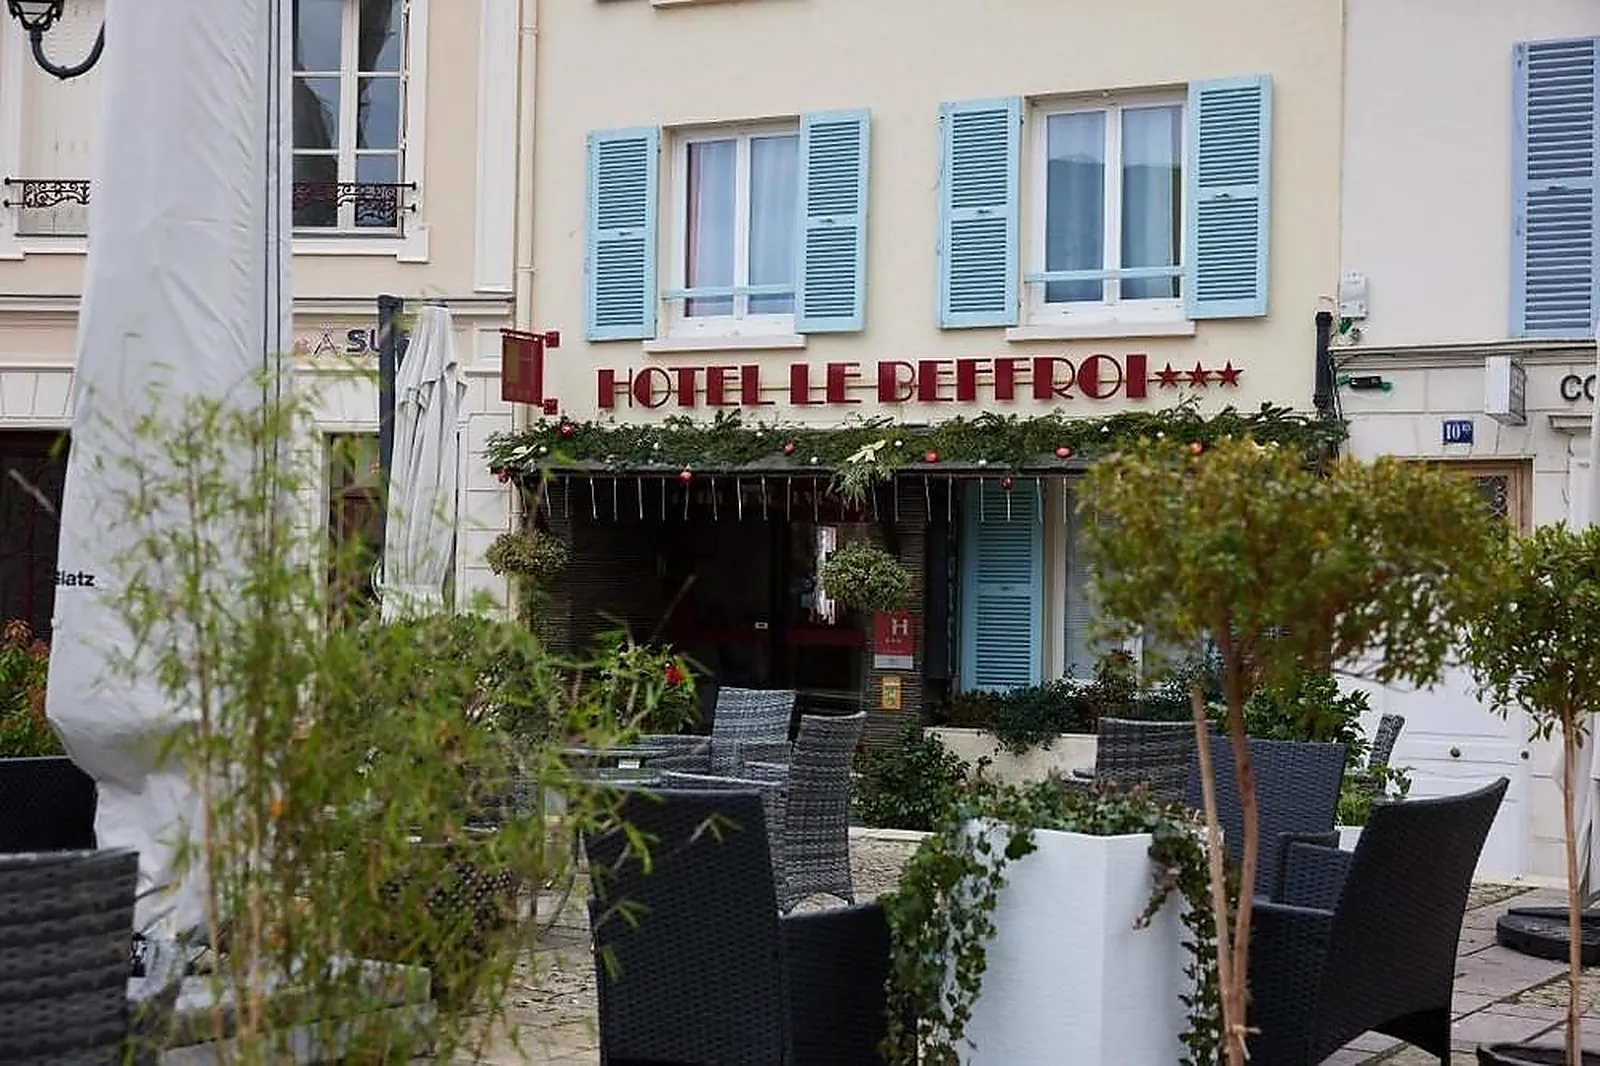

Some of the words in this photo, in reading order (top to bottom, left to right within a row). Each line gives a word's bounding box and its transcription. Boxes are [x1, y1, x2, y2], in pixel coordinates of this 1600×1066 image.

[597, 364, 775, 408] HOTEL
[790, 361, 862, 405] LE
[877, 353, 1148, 403] BEFFROI
